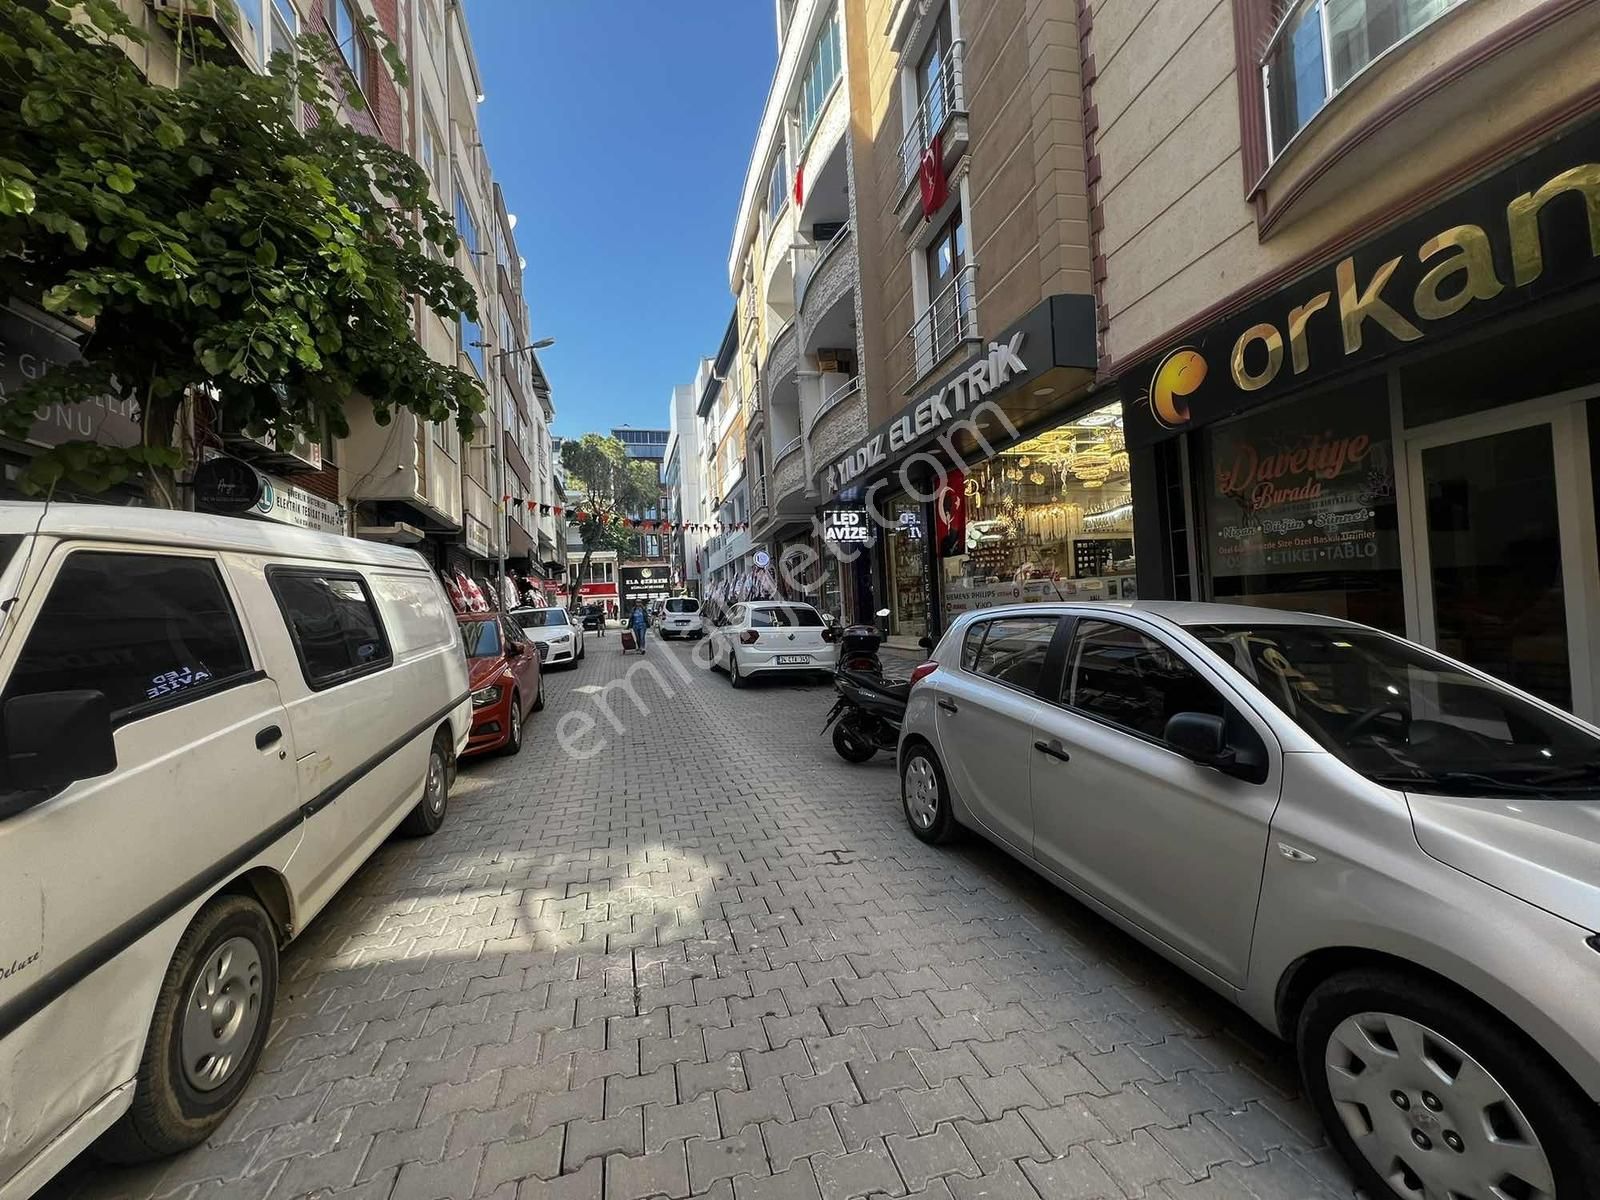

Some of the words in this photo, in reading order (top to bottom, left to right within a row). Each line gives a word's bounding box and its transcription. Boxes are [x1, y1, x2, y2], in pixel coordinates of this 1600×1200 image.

[888, 331, 1028, 452] ELEKTRİK
[1216, 433, 1369, 494] Davetiye
[1250, 477, 1322, 511] Burada
[826, 525, 867, 540] AVİZE
[832, 512, 859, 526] LED
[1326, 541, 1377, 561] TABLO
